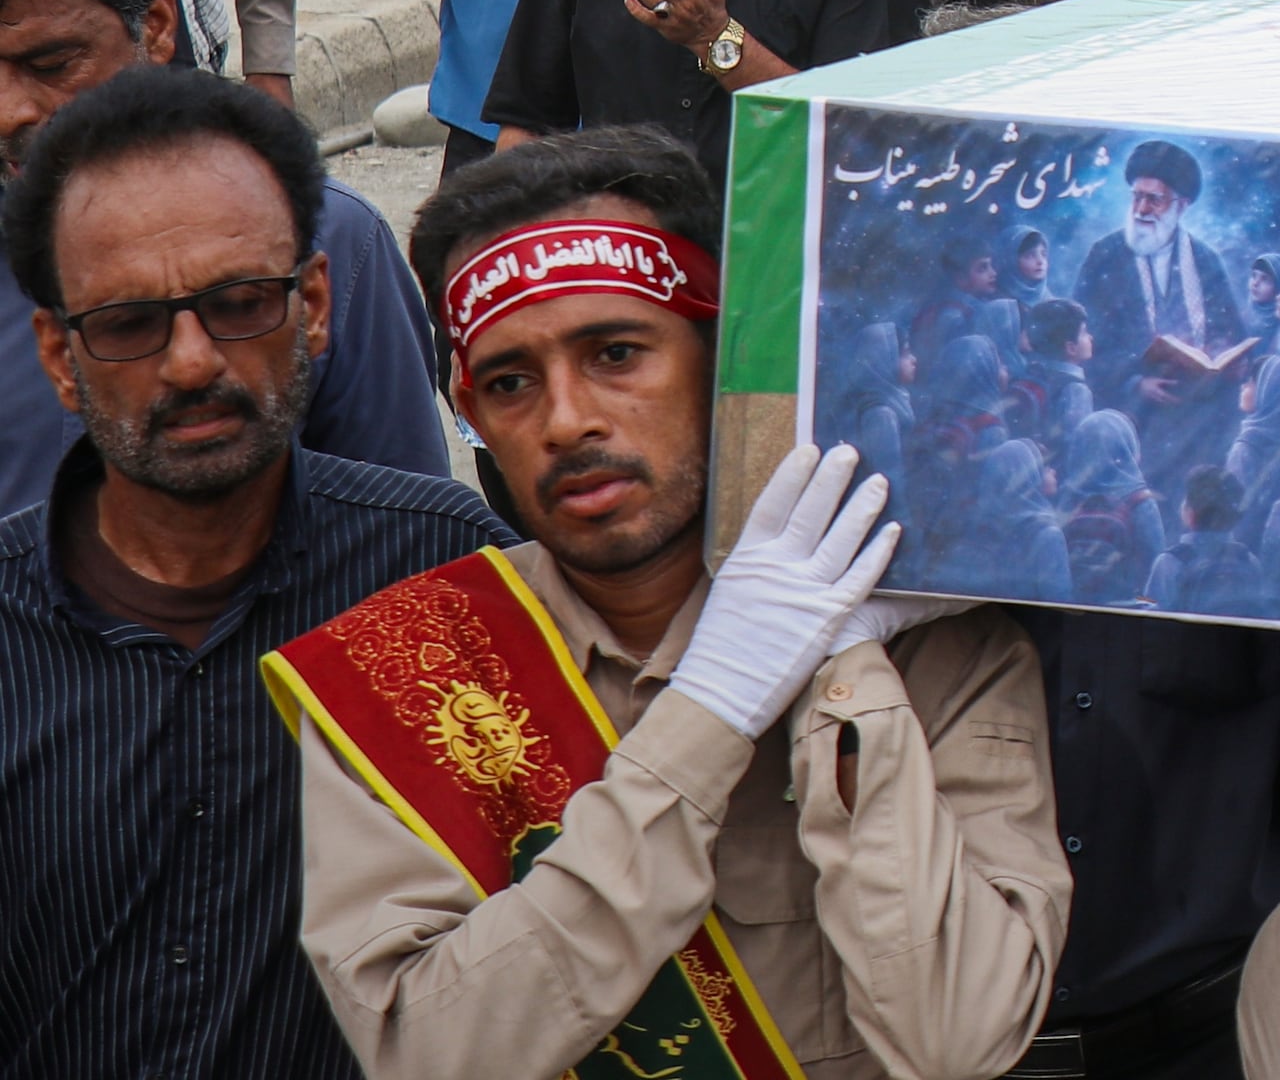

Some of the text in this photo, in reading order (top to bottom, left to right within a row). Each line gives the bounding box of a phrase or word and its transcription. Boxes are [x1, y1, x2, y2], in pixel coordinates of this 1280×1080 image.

[834, 122, 1110, 215] شهدای شجره طیبه میناب
[457, 252, 520, 324] العباس
